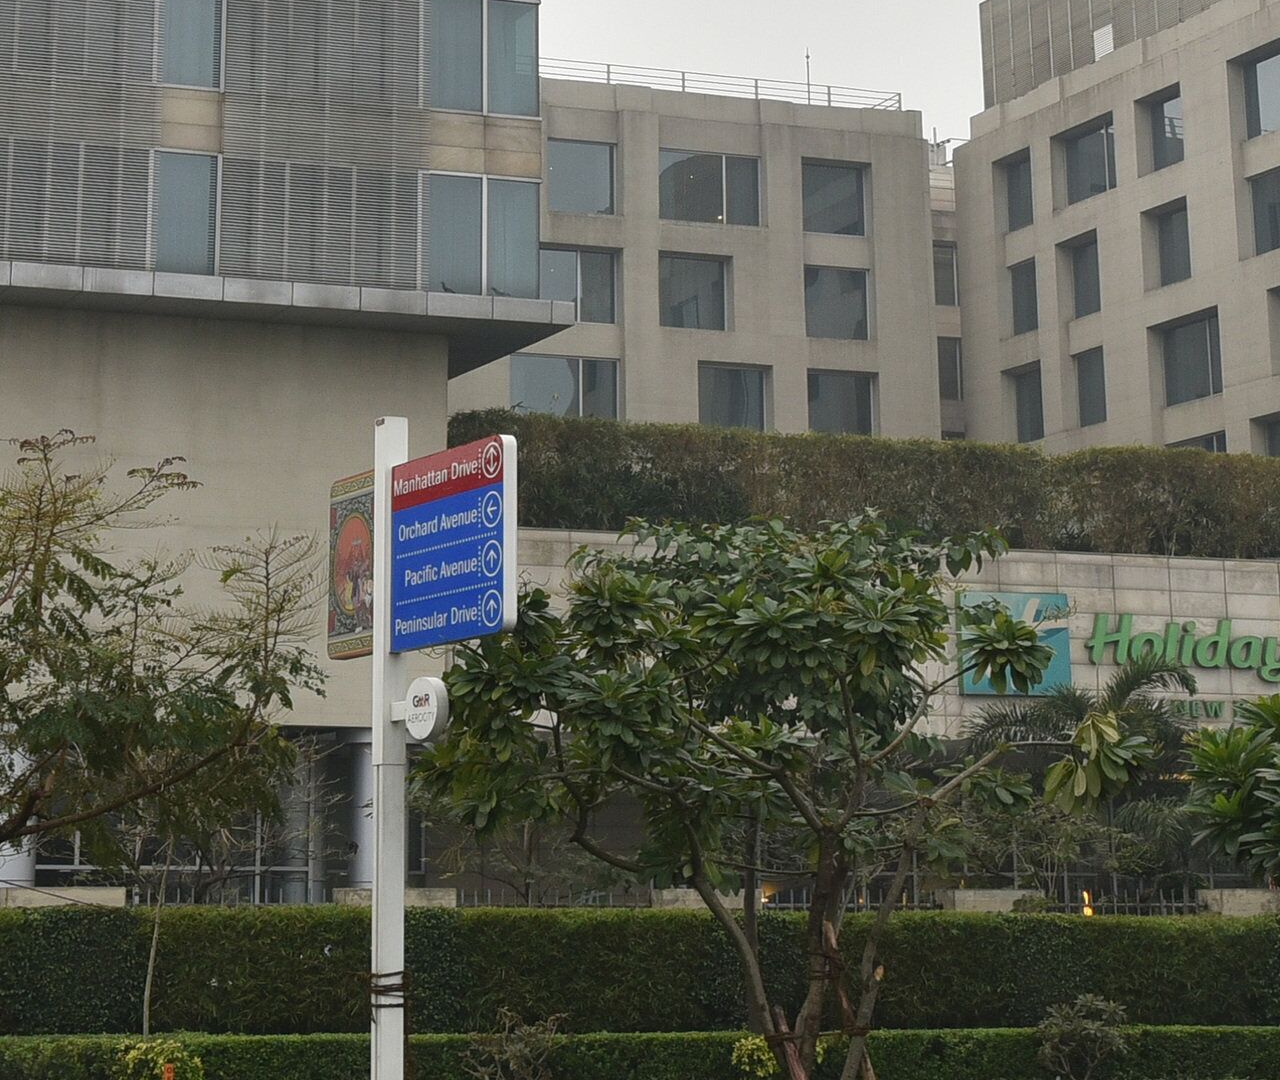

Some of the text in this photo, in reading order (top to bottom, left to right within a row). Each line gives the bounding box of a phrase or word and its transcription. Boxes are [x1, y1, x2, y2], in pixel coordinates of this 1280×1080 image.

[393, 459, 478, 497] Manhattan Drive
[398, 507, 478, 542] Orchard Avenue
[404, 557, 478, 587] Pacific Avenue
[394, 604, 478, 636] Peninsular Drive
